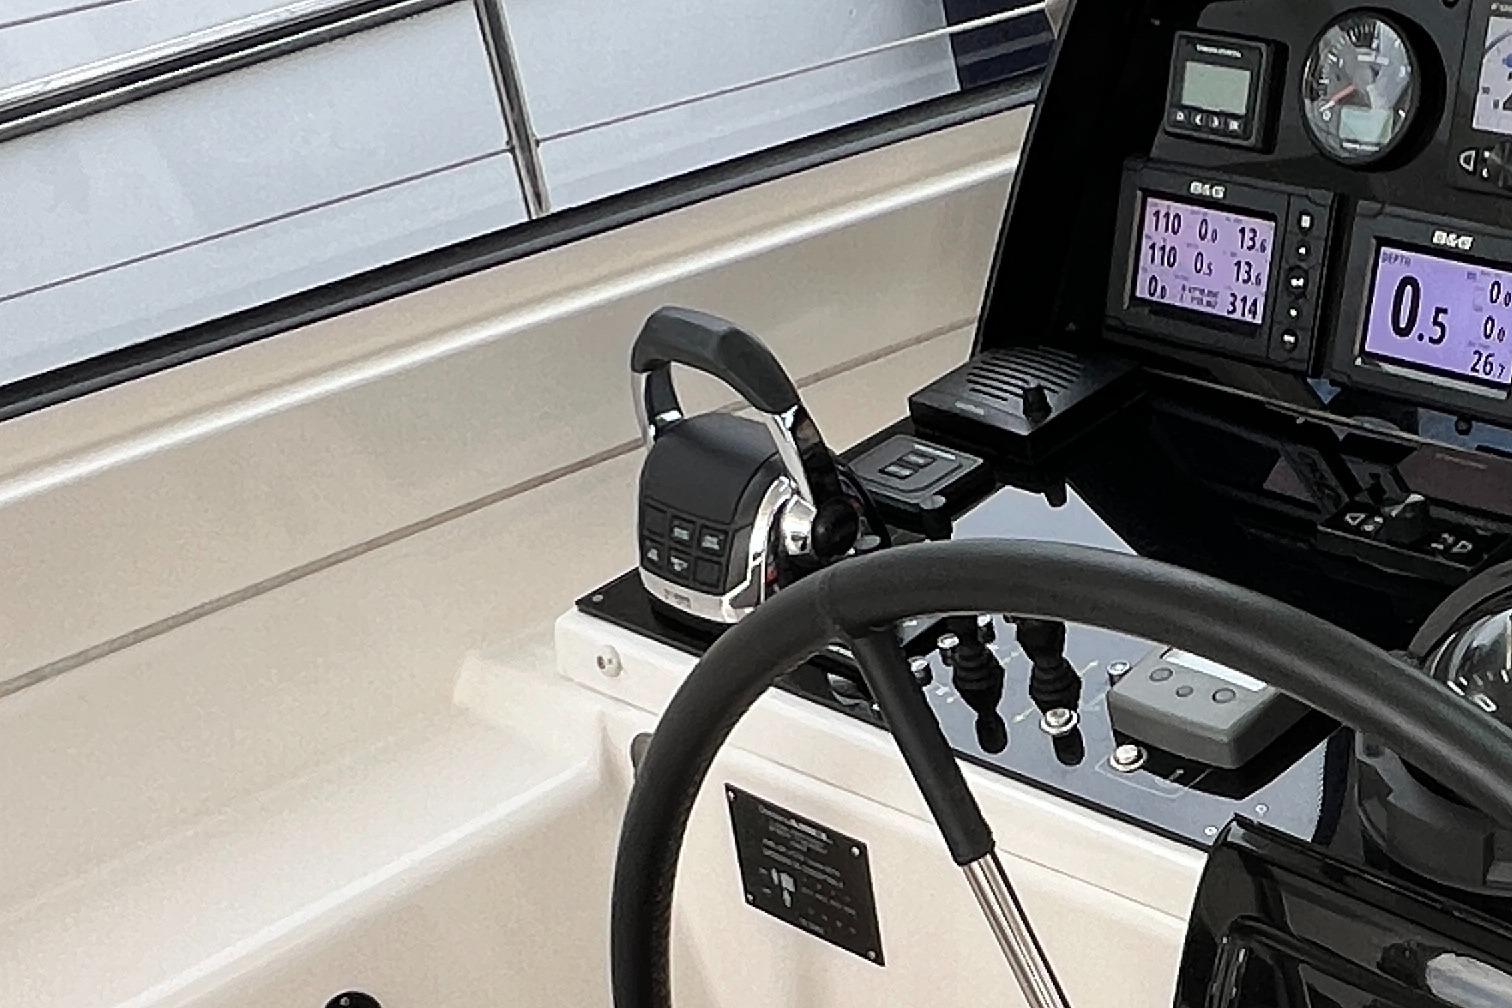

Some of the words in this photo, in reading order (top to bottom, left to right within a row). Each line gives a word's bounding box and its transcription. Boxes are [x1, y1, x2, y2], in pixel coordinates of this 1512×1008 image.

[1153, 210, 1182, 236] 110
[1148, 242, 1178, 268] 110
[1226, 292, 1259, 320] 314
[1390, 274, 1449, 346] 0.5
